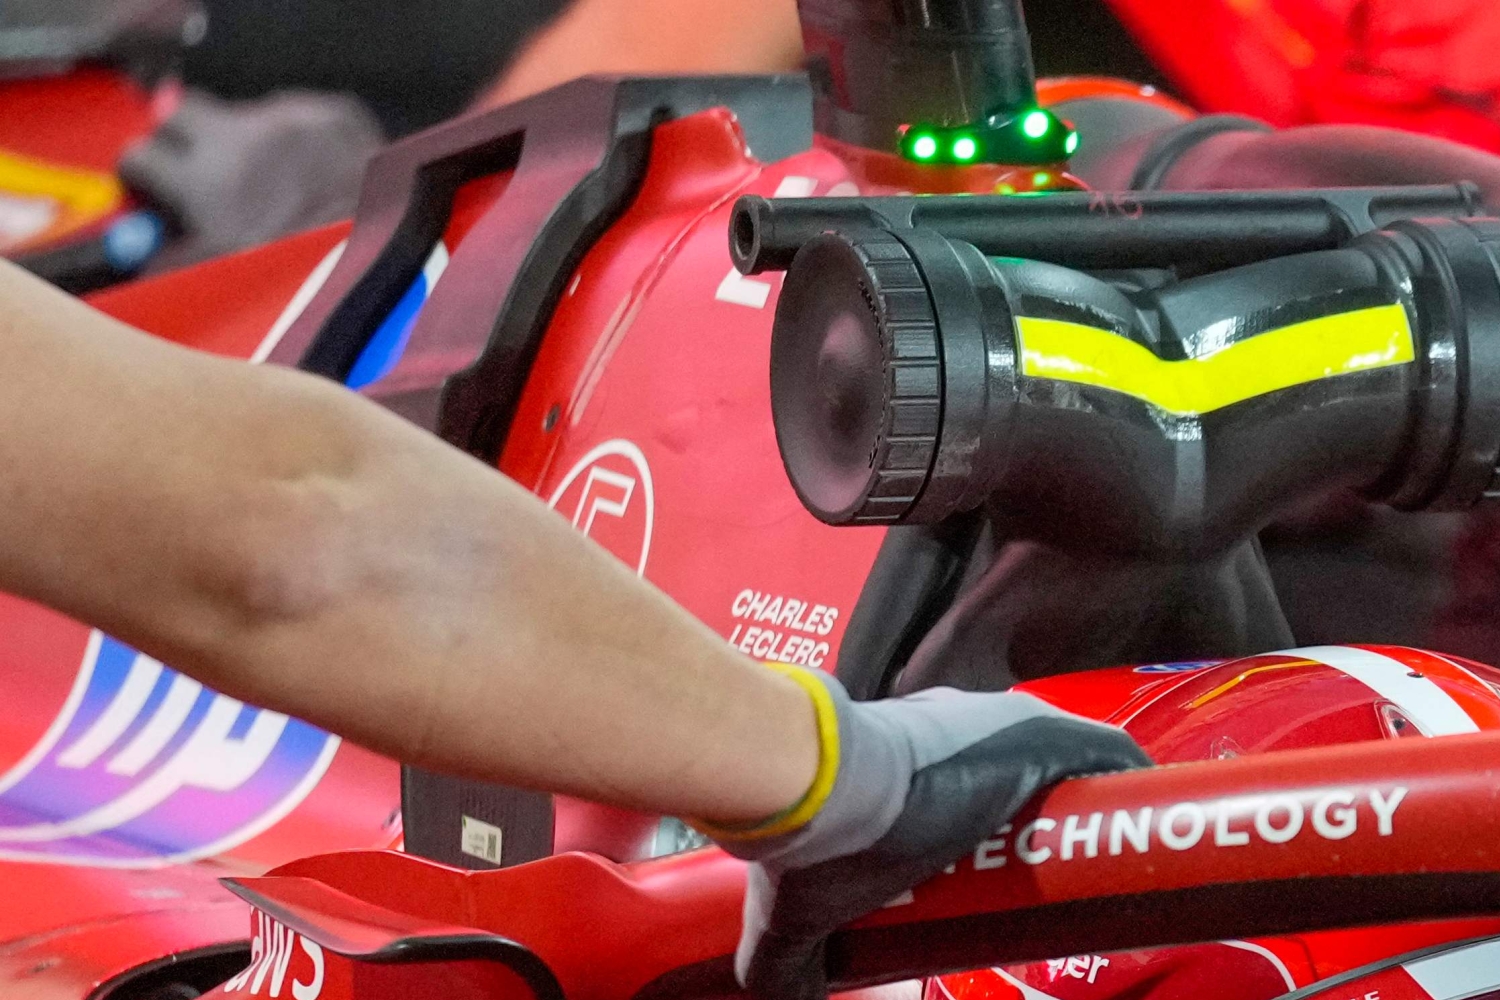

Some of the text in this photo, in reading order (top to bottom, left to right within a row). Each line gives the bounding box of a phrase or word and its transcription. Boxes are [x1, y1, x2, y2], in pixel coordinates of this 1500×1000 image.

[731, 588, 839, 635] CHARLES
[728, 623, 830, 668] LECLERC
[944, 786, 1409, 875] ECHNOLOGY
